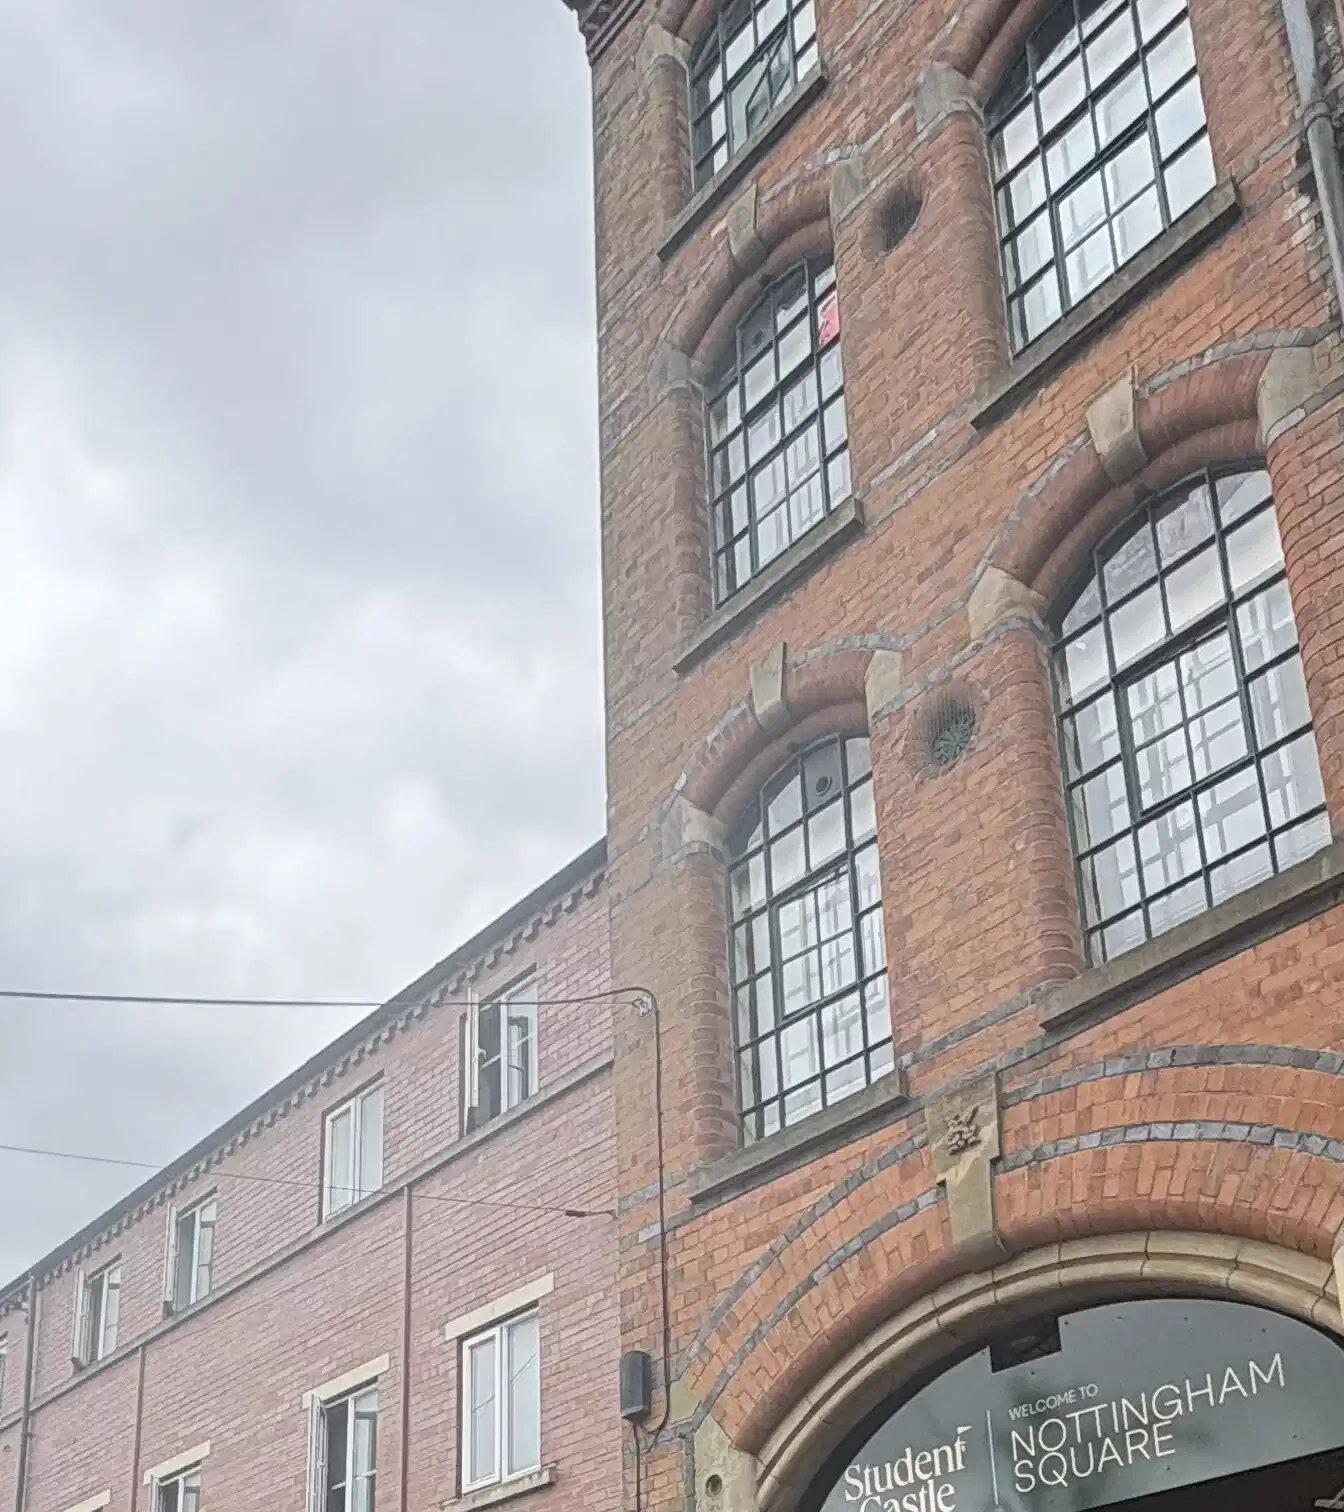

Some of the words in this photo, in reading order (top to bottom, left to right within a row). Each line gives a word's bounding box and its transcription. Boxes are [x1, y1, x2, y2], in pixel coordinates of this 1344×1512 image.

[1008, 1391, 1077, 1421] WELCOME
[1078, 1383, 1098, 1400] TO
[1011, 1352, 1286, 1461] NOTTINGHAM
[844, 1425, 973, 1502] Student
[1014, 1420, 1176, 1493] SQUARE
